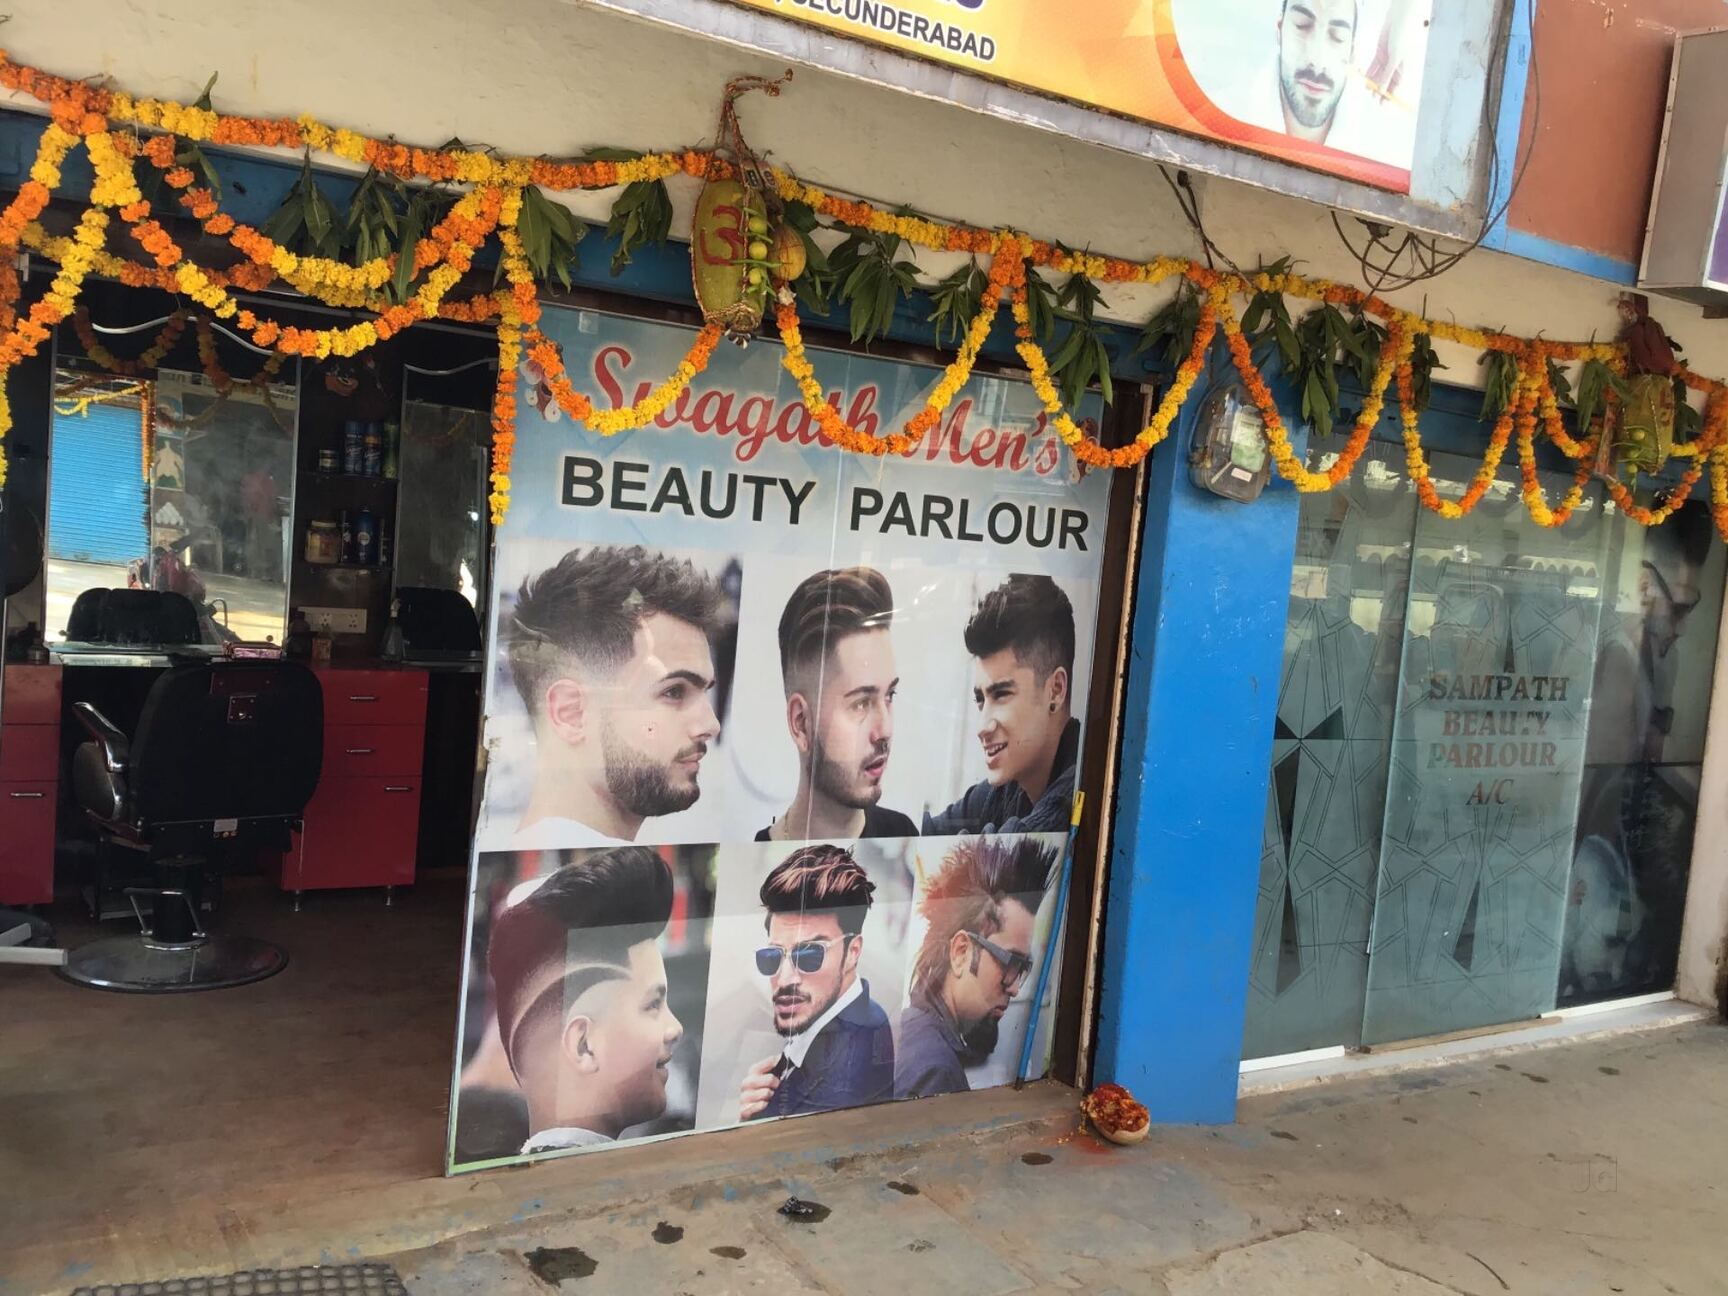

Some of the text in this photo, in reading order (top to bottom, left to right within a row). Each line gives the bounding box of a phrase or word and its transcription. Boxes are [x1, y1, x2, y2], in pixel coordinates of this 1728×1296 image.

[561, 456, 1090, 552] BEAUTY PARLOUR
[1429, 672, 1571, 702] SAMPATH
[1426, 742, 1558, 769] PARLOUR
[1465, 778, 1515, 807] A/C
